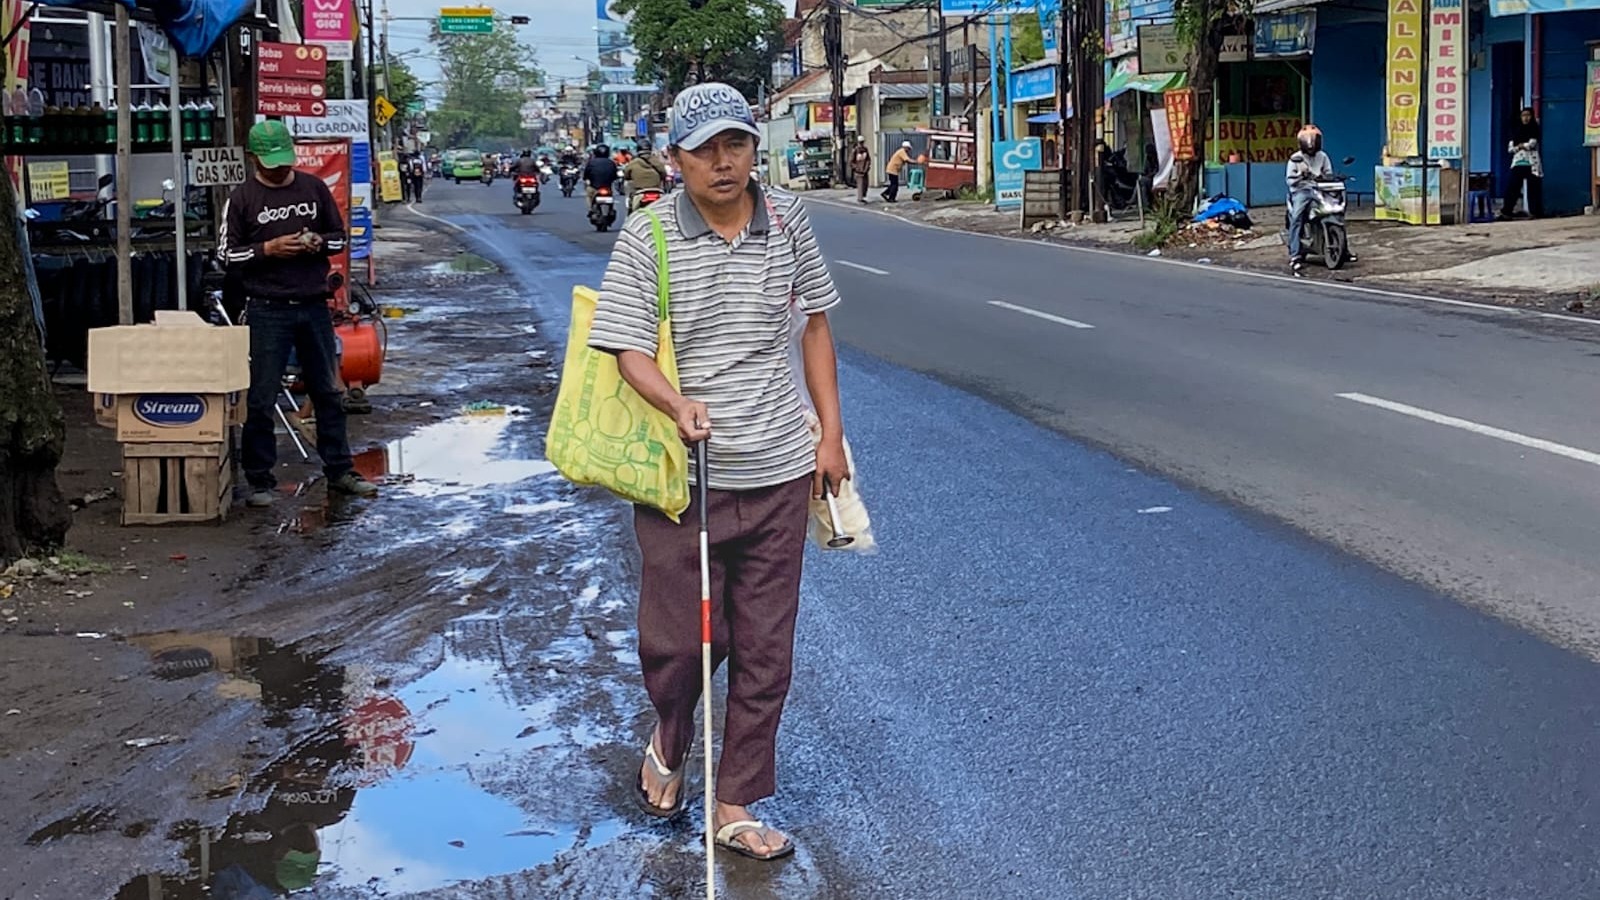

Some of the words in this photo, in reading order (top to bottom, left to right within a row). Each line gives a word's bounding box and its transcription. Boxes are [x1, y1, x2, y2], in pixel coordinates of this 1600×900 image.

[316, 20, 341, 28] GIGI
[1433, 13, 1460, 57] MIE
[259, 47, 283, 58] Bebas
[259, 62, 279, 72] Antri
[258, 82, 283, 93] Servis
[285, 84, 310, 96] Injeksi
[258, 101, 277, 111] Free
[279, 101, 301, 112] Snack
[327, 105, 353, 116] ESIN
[1434, 66, 1456, 141] KOCOK
[685, 102, 746, 129] STONE
[292, 122, 311, 133] OLI
[315, 122, 366, 133] GARDAN
[1205, 120, 1257, 141] UBUR
[198, 149, 239, 163] JUAL
[1430, 146, 1460, 157] ASLI
[196, 166, 219, 183] GAS
[222, 164, 243, 182] 3KG
[141, 400, 200, 415] Stream
